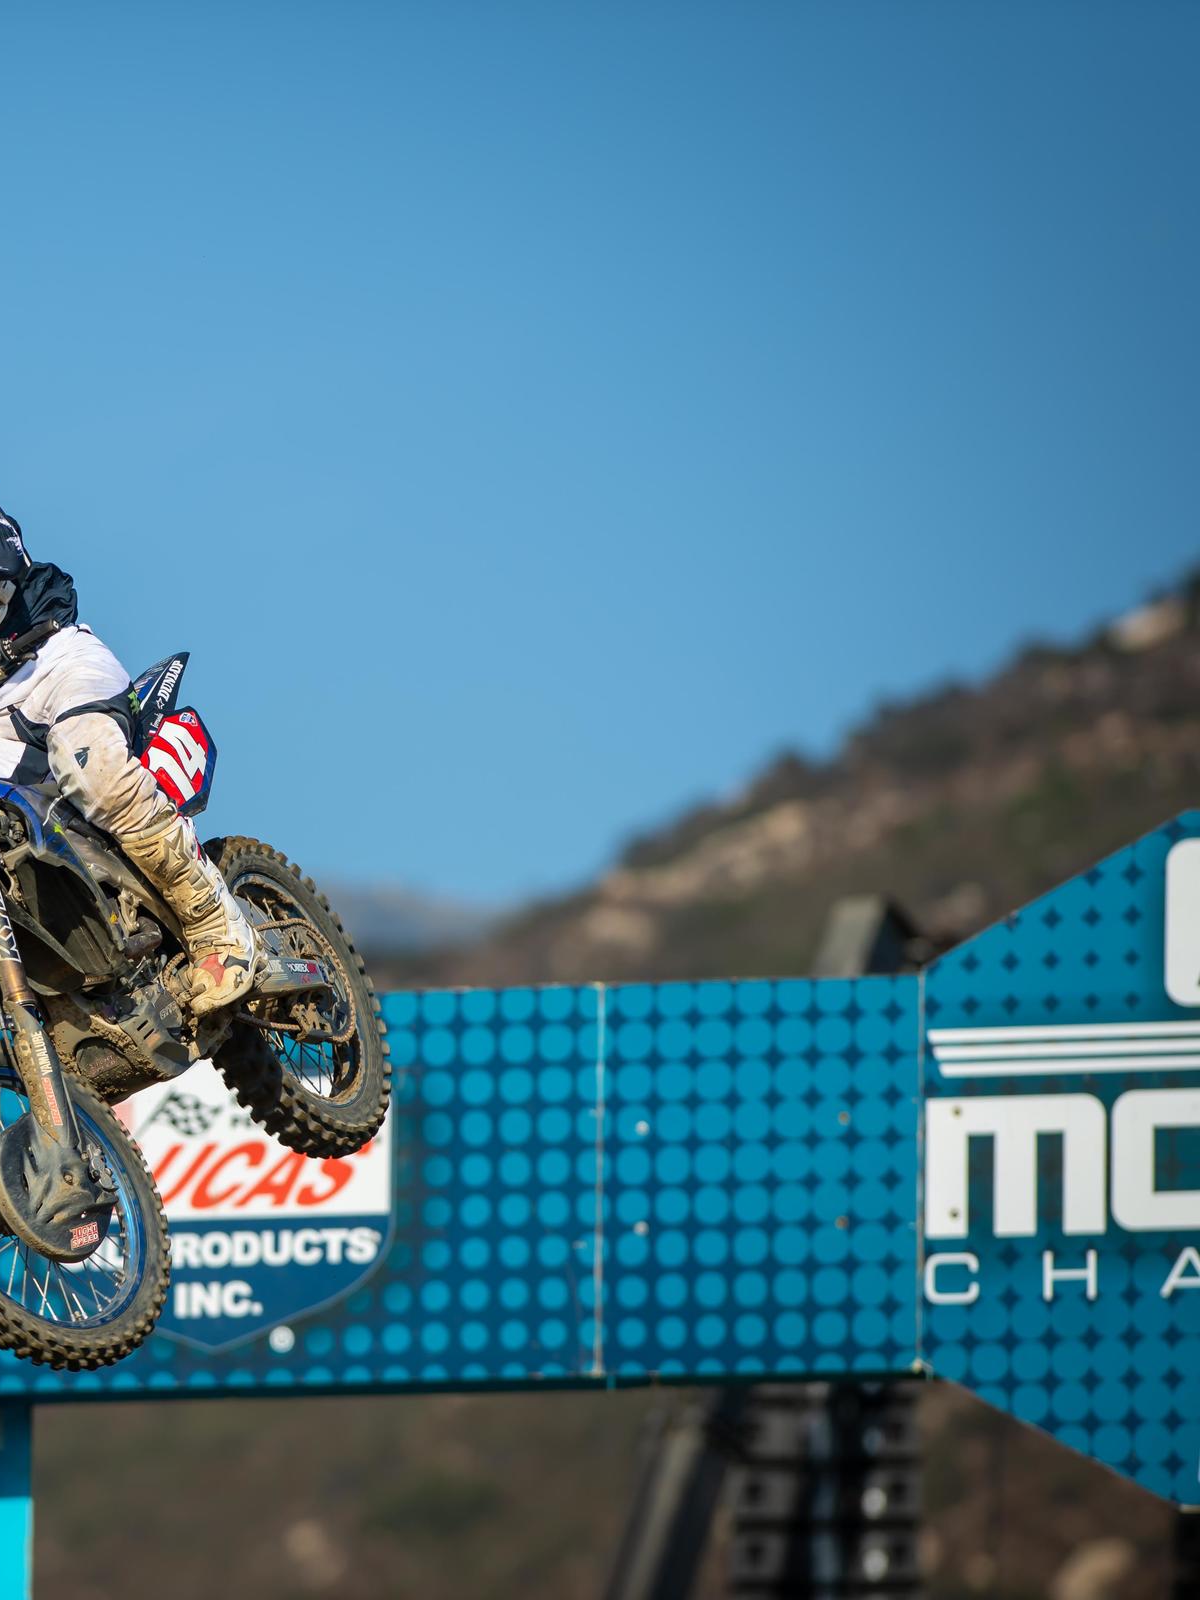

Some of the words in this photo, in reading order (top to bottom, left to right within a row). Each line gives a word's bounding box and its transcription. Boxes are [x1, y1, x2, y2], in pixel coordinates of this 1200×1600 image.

[157, 660, 183, 702] DUNLOP
[31, 1031, 54, 1076] YAMALUBE
[41, 1077, 63, 1126] BRAKING
[153, 1140, 372, 1209] UCAS
[72, 1233, 99, 1248] SPEED
[166, 1226, 381, 1269] RODUCTS
[173, 1279, 263, 1318] INC.
